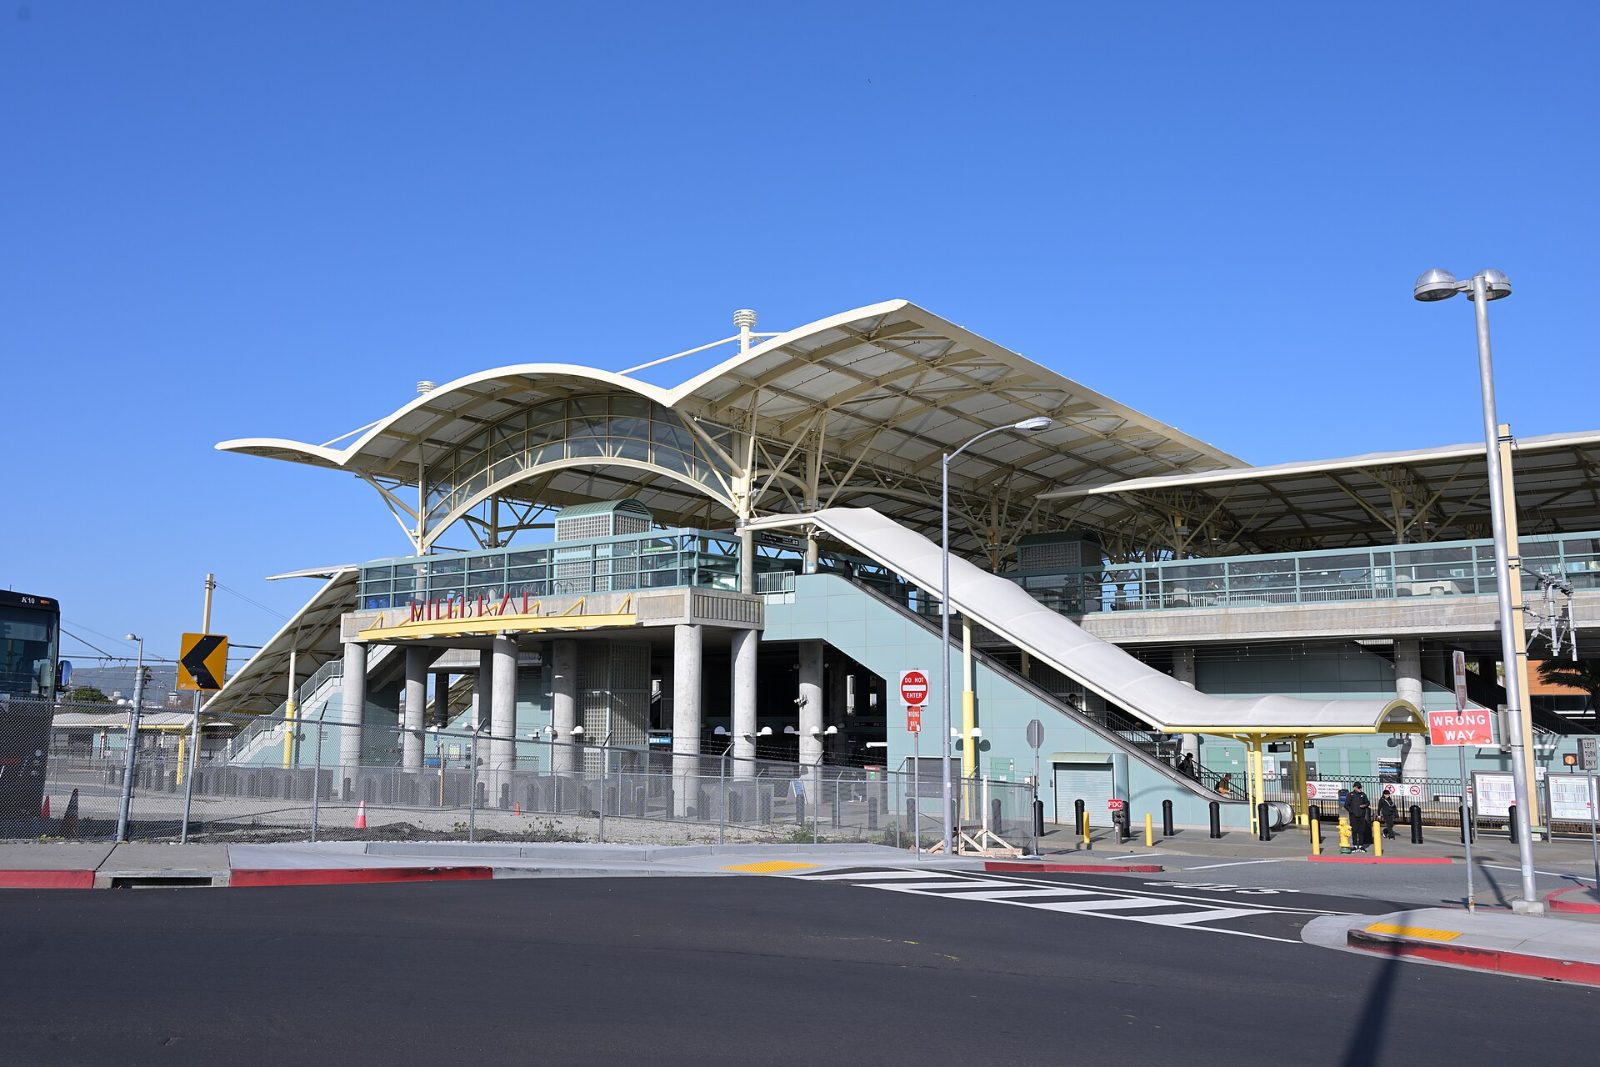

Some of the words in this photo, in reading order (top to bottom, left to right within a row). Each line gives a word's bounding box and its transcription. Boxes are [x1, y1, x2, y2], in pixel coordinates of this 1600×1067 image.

[1433, 714, 1486, 727] WRONG
[1444, 730, 1476, 741] WAY
[1583, 741, 1595, 749] LEFT
[1584, 750, 1596, 758] TURN
[1585, 759, 1596, 767] ONLY
